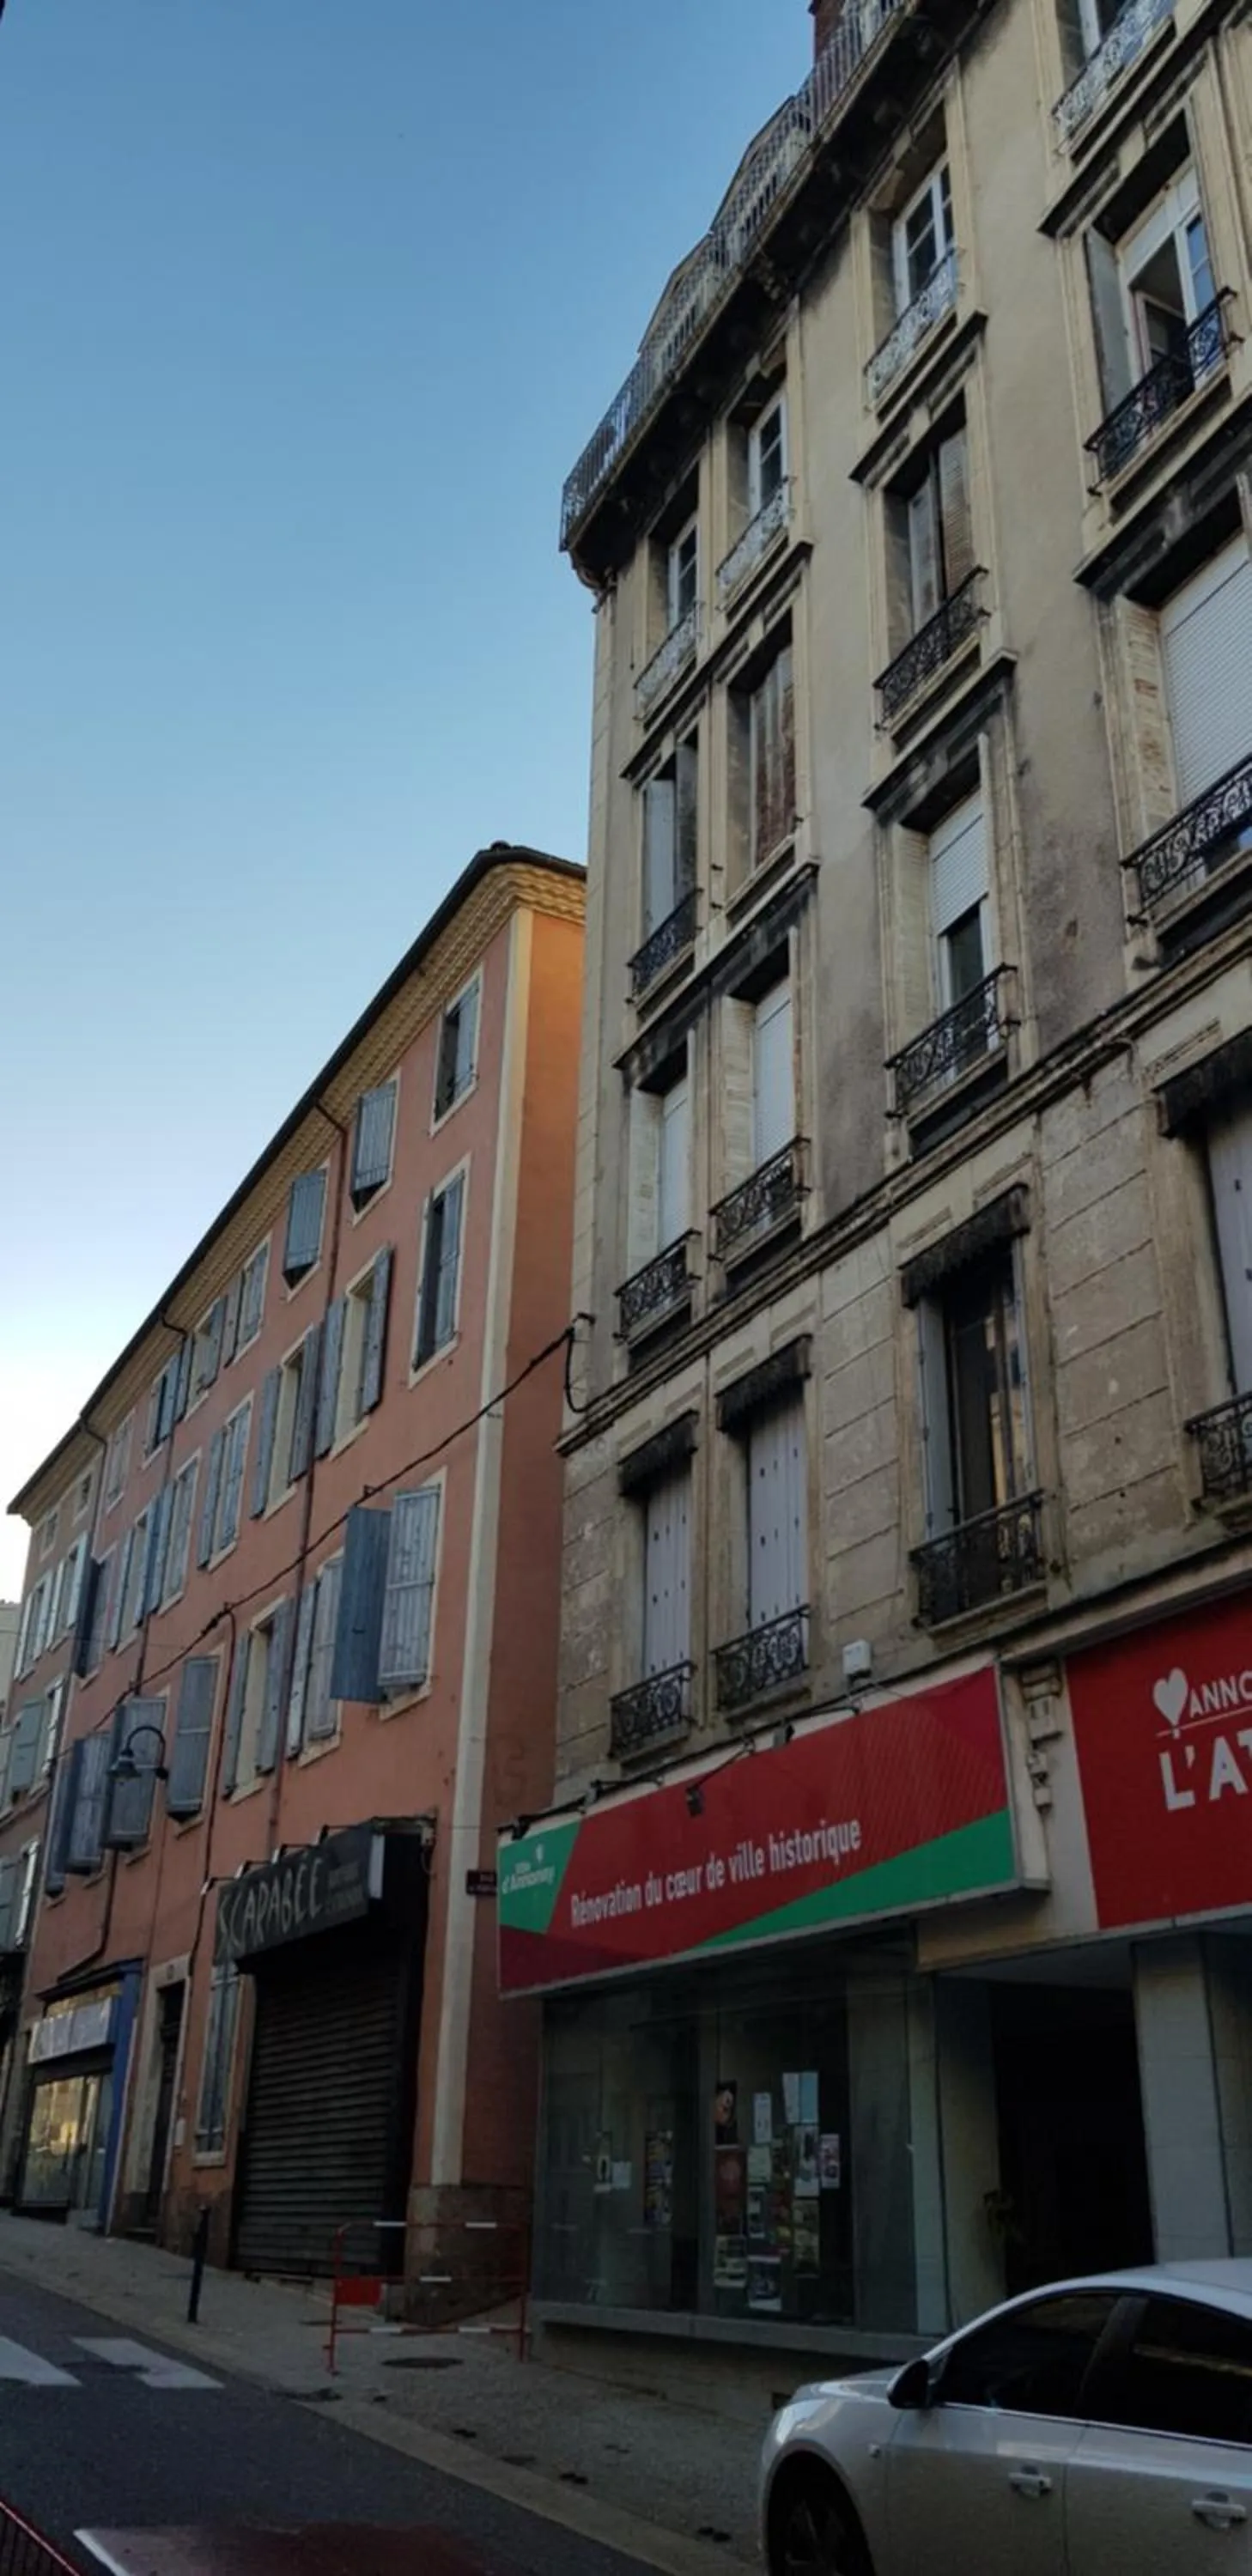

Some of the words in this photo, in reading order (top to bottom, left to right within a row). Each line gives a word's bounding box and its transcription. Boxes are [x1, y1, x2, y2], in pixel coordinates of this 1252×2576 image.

[571, 1879, 642, 1928] Rénovation
[645, 1870, 664, 1906] du
[706, 1851, 725, 1892] de
[728, 1840, 764, 1883] ville
[769, 1819, 861, 1872] historique
